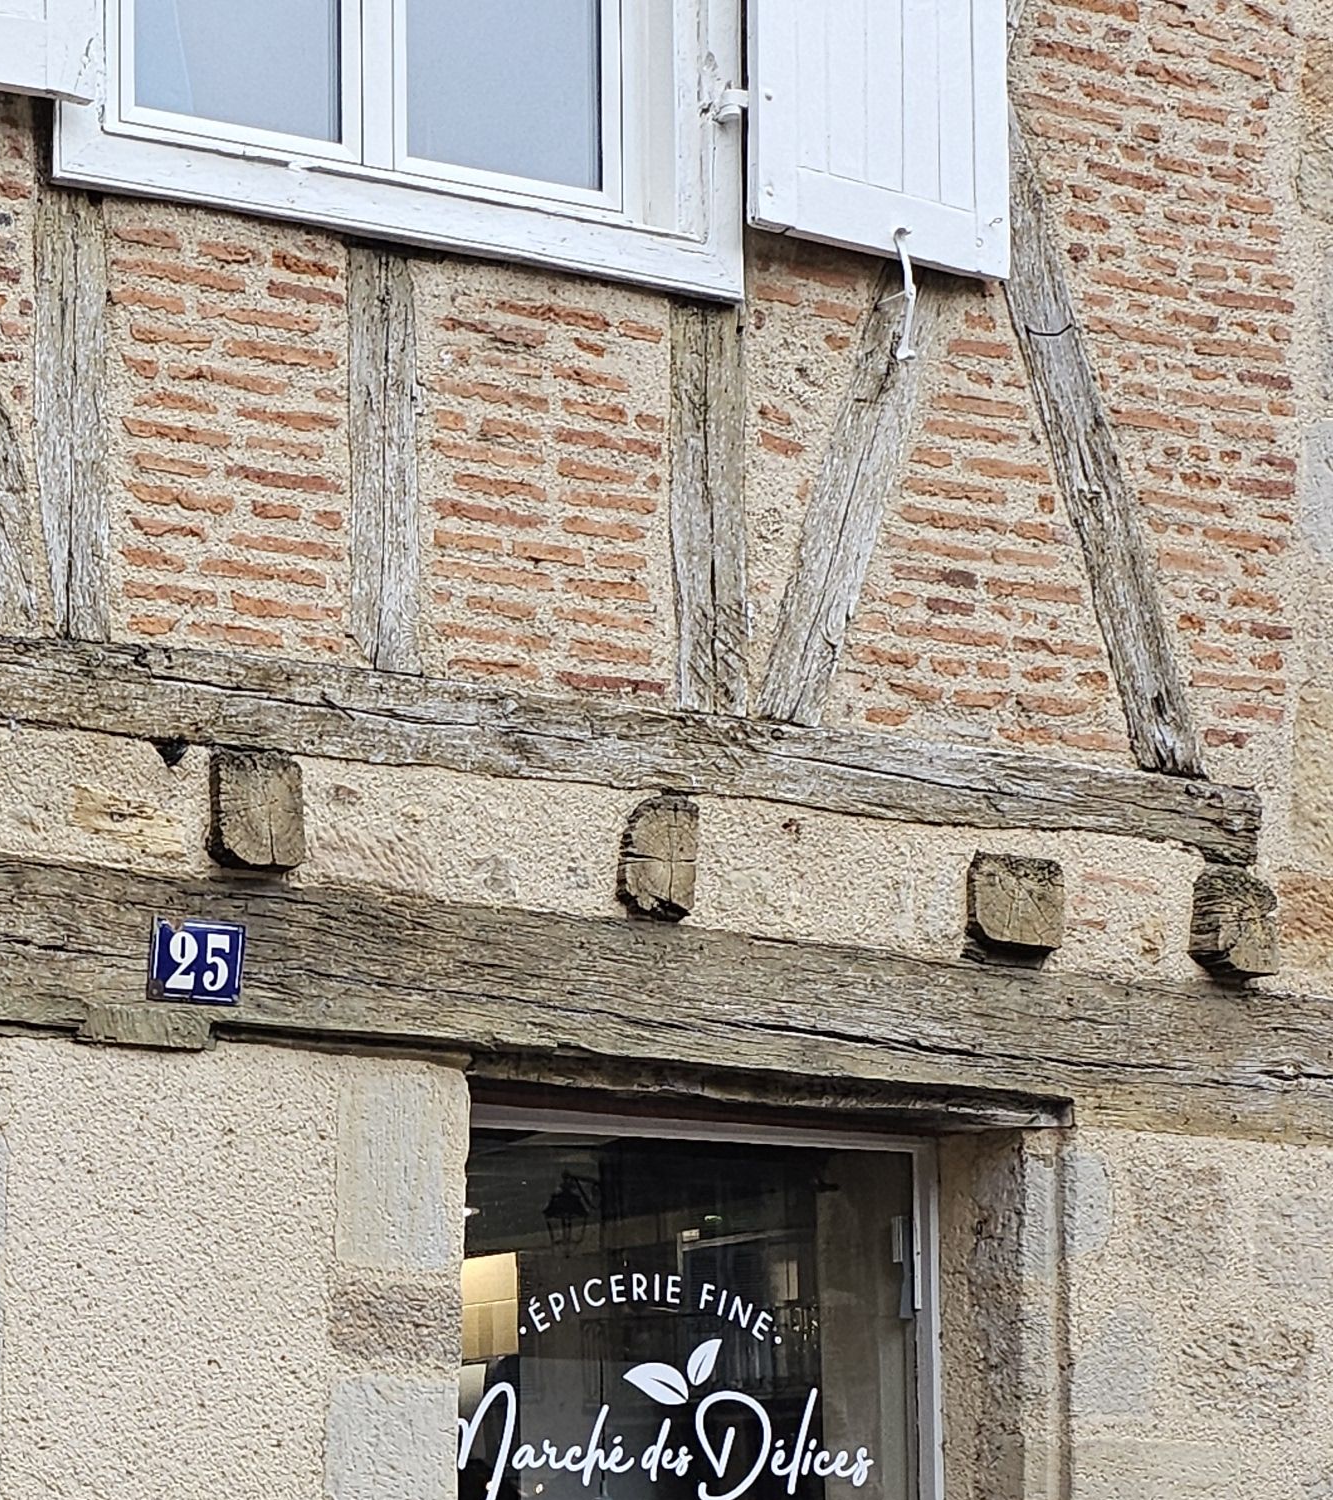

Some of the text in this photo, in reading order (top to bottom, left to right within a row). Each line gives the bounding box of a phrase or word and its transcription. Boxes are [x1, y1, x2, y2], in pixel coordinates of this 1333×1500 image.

[165, 931, 230, 991] 25
[526, 1272, 774, 1342] ÉPICERIE FINE
[640, 1417, 693, 1482] des
